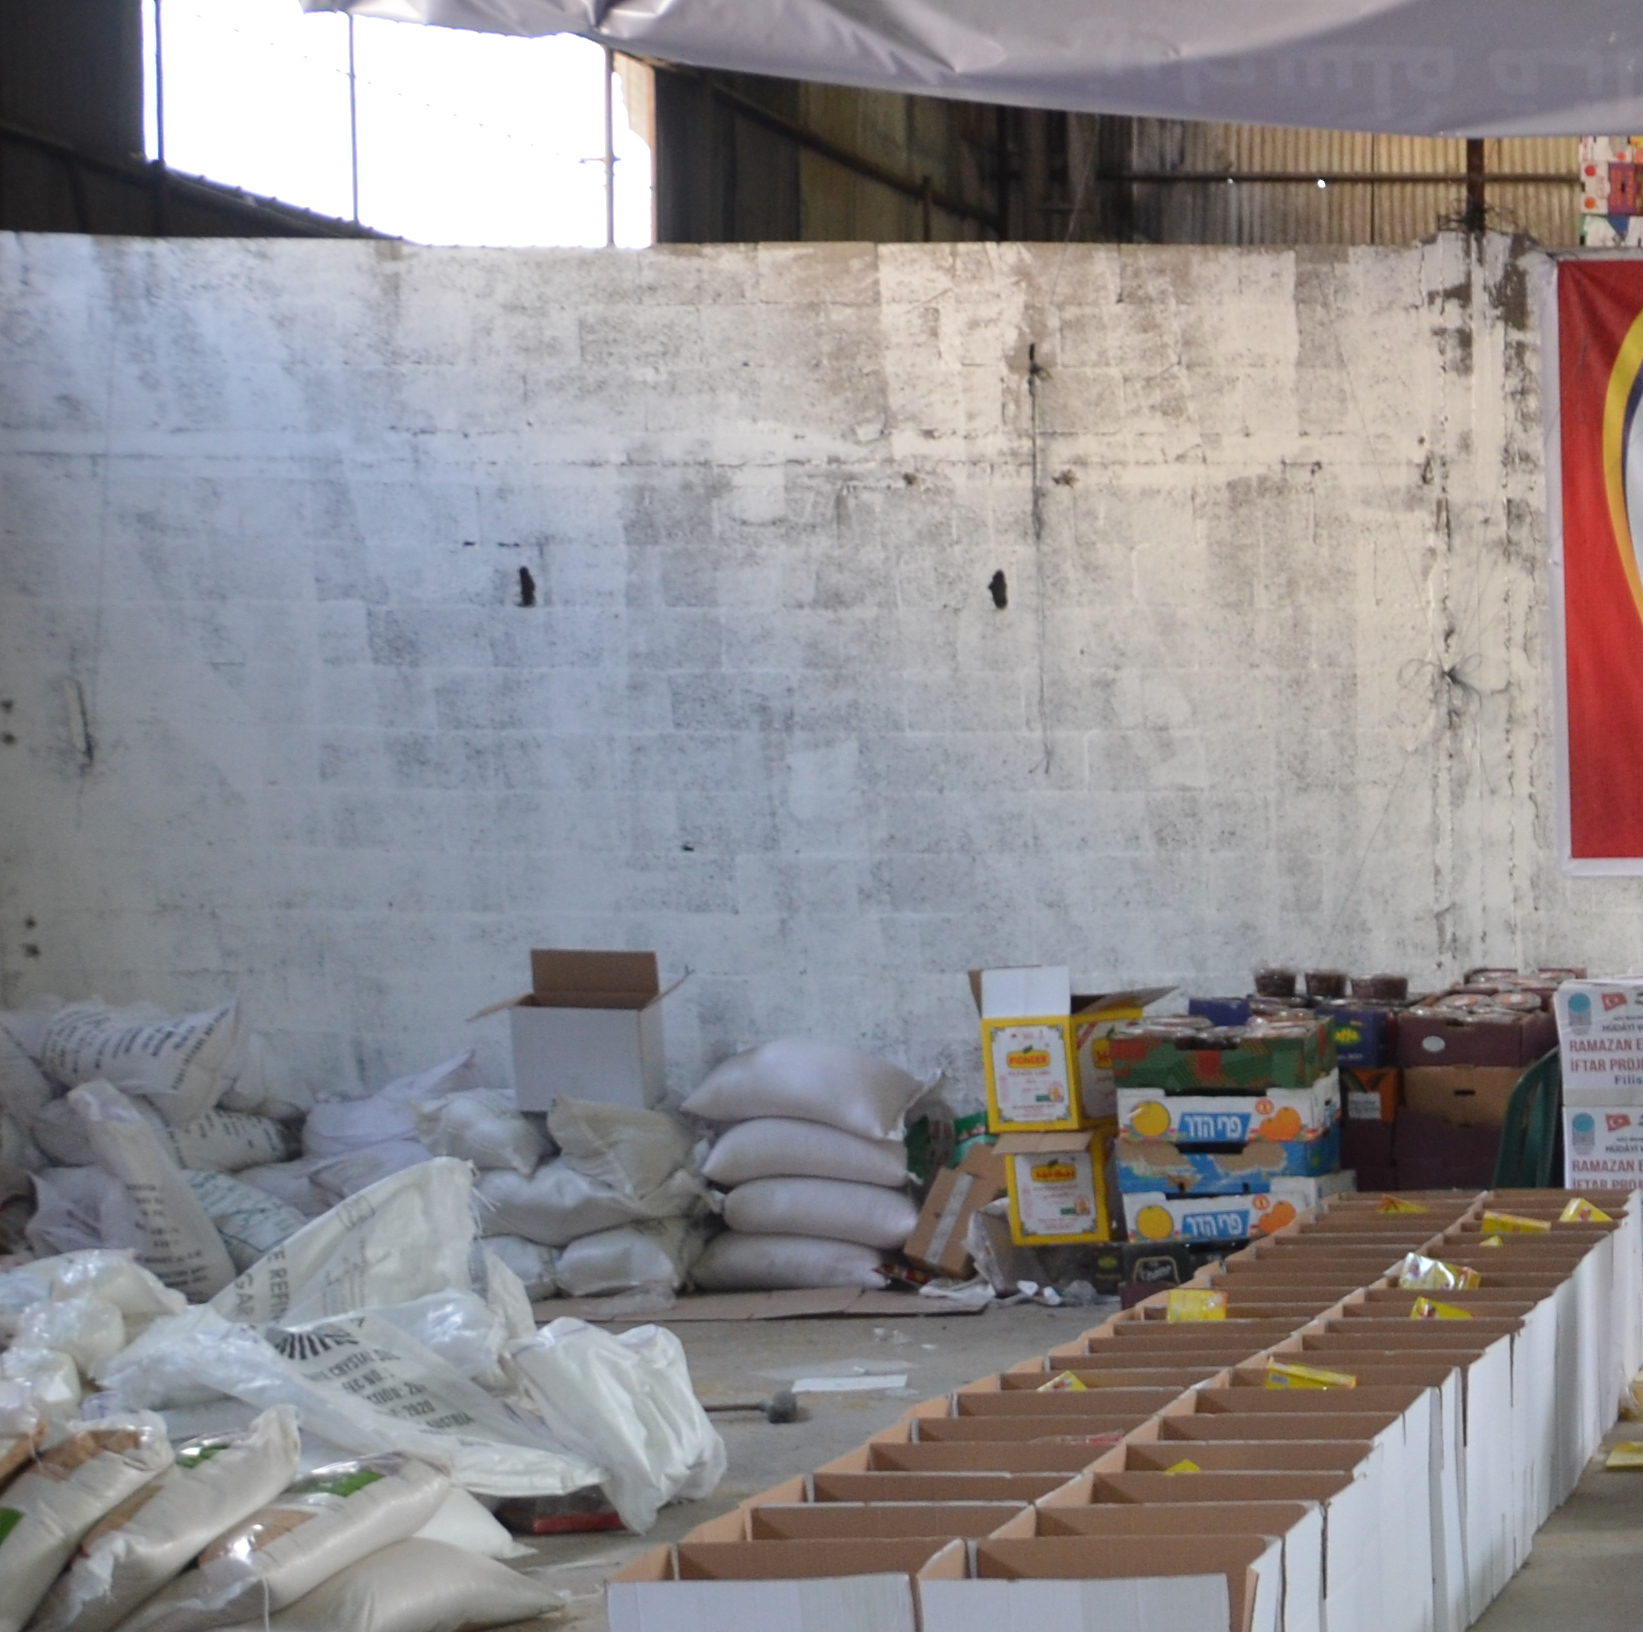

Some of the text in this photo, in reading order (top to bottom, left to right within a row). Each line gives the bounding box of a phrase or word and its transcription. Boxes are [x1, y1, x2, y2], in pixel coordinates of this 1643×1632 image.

[1569, 1039, 1632, 1053] RAMAZAN
[1184, 1115, 1243, 1139] פרי הדר
[1572, 1159, 1635, 1172] RAMAZAN
[1186, 1213, 1243, 1237] פרי הדר
